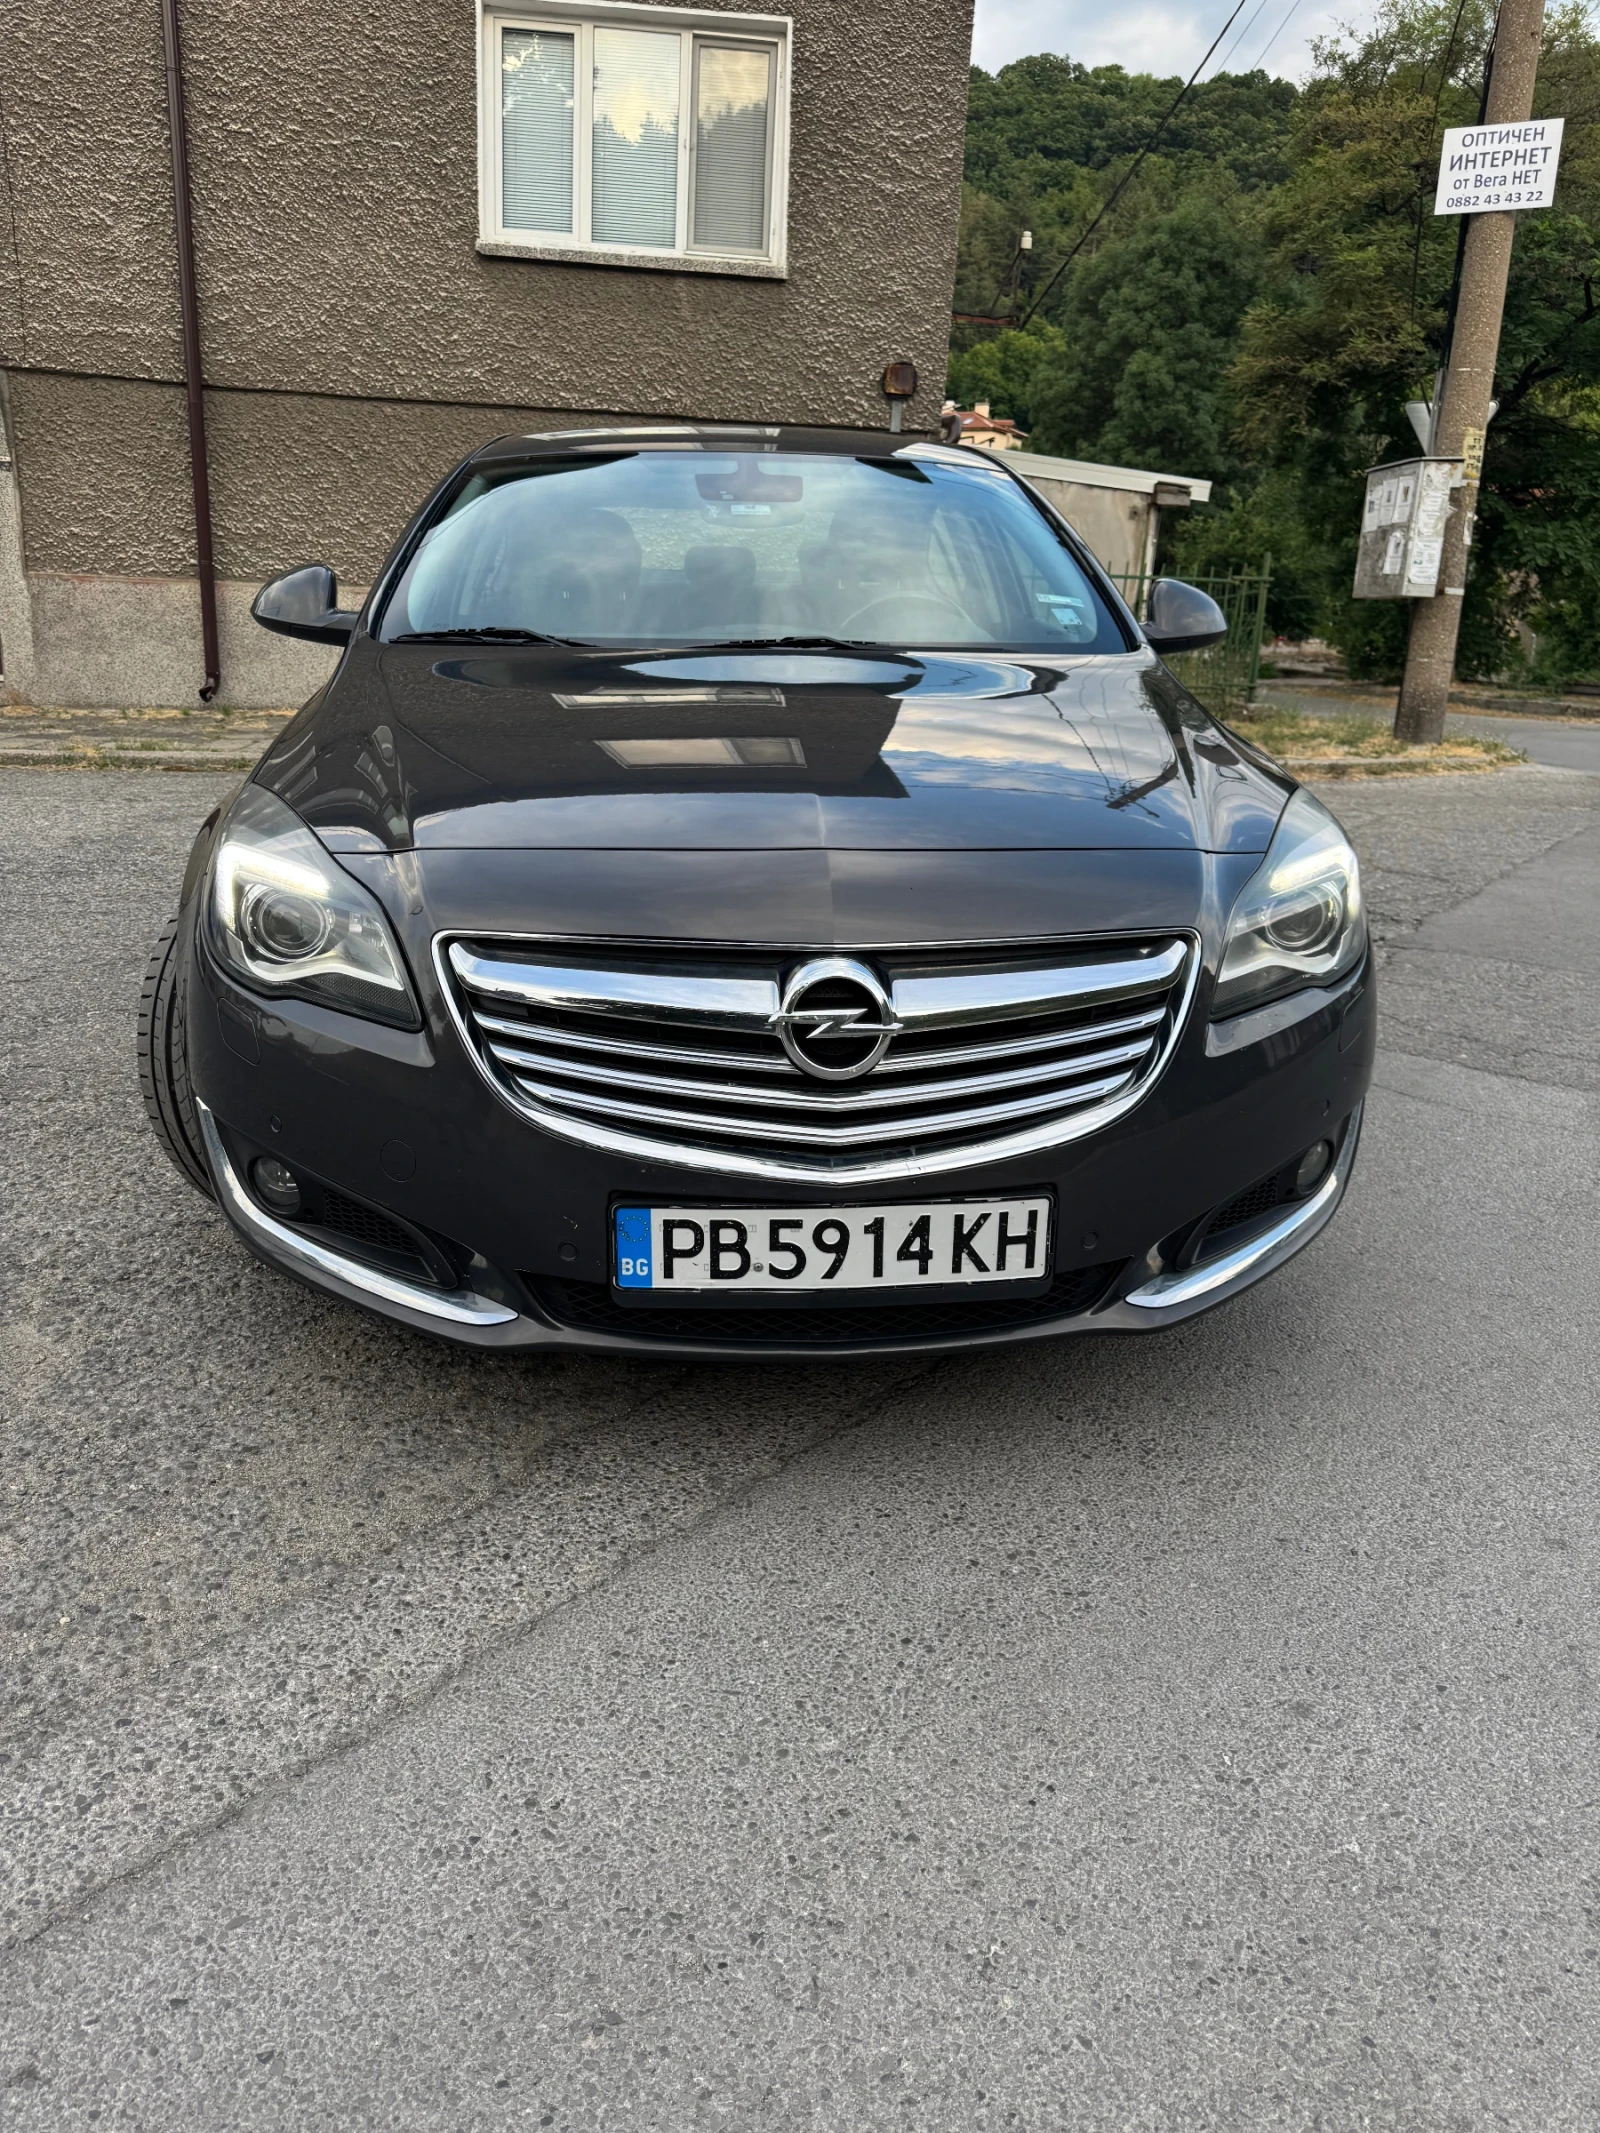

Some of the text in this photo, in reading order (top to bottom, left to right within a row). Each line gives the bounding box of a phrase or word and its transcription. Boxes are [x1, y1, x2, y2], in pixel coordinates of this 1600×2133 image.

[1462, 127, 1545, 148] ОПТИЧЕН
[1449, 147, 1552, 171] ИНТЕРНЕТ
[1453, 169, 1542, 190] от Вега НЕТ
[1446, 191, 1543, 208] 0882 43 43 22
[621, 1257, 649, 1276] BG
